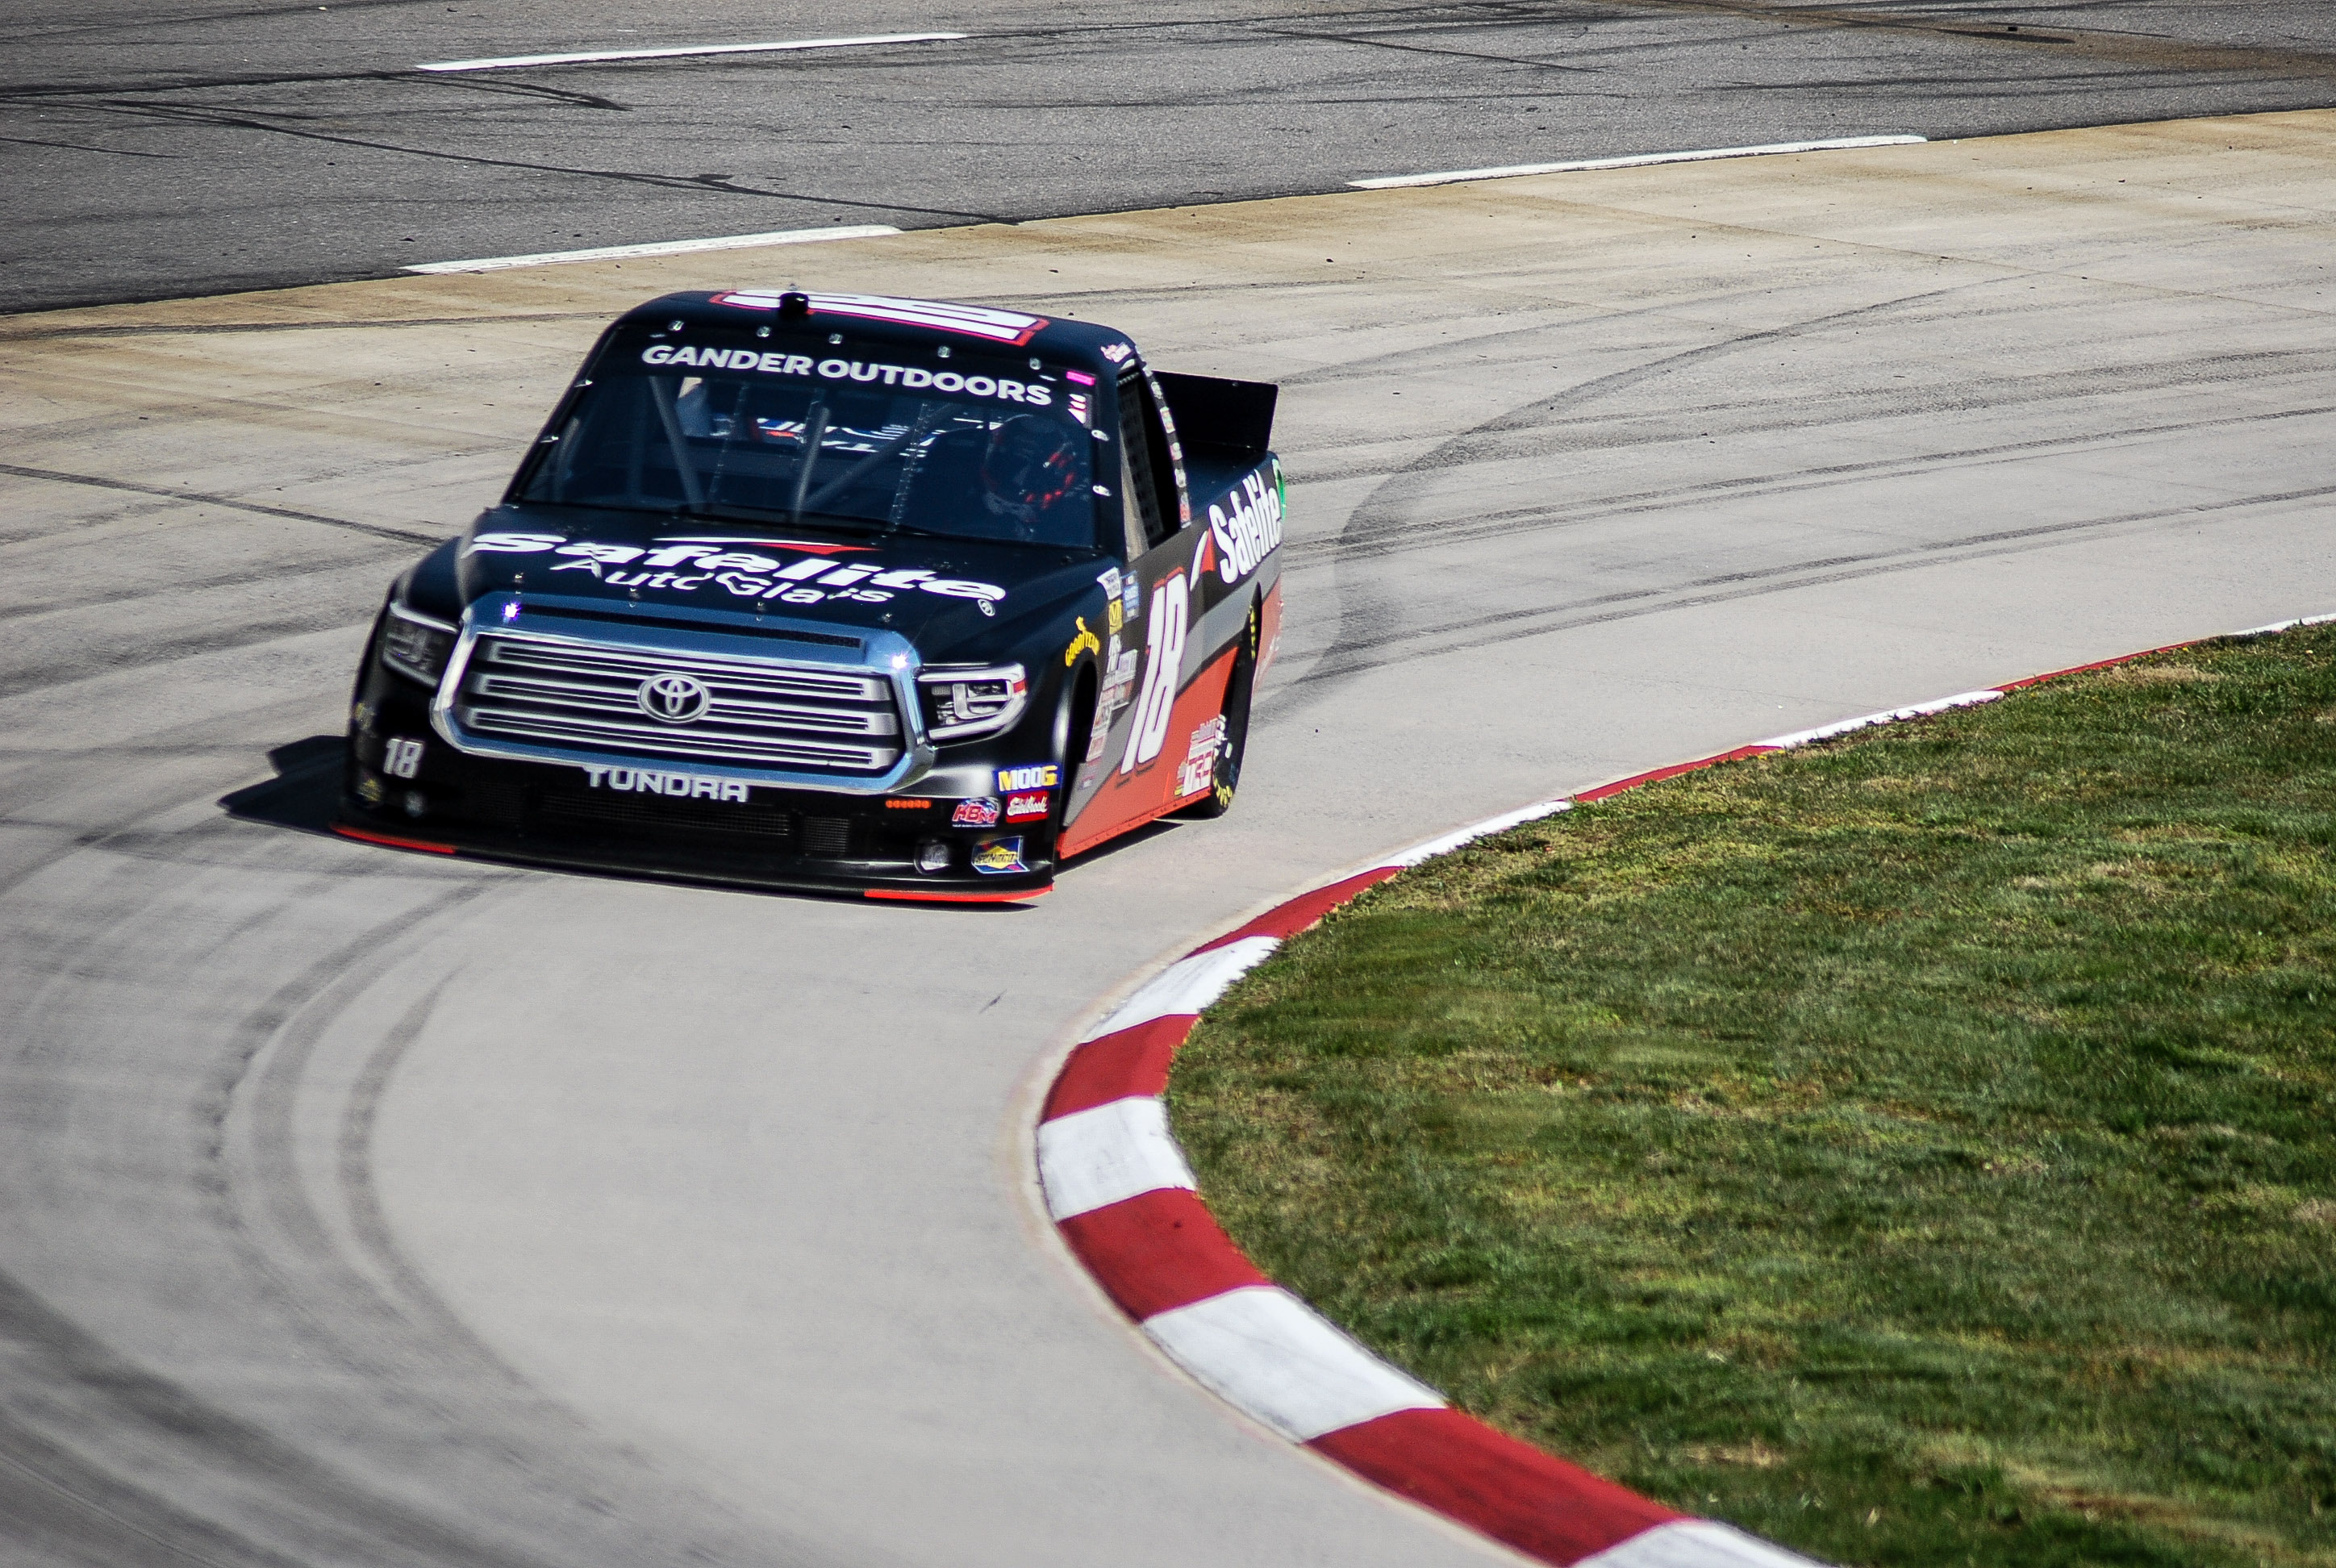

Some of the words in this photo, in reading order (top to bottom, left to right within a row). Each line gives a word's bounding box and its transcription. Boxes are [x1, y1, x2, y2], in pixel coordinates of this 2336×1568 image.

[642, 344, 813, 376] GANDER
[817, 359, 1052, 407] OUTDOORS
[1208, 469, 1281, 583] Safelite
[461, 532, 1006, 602] Safelite
[1120, 573, 1188, 775] 18
[383, 737, 424, 778] 18
[582, 765, 748, 803] TUNDRA
[998, 765, 1058, 792] MOOG
